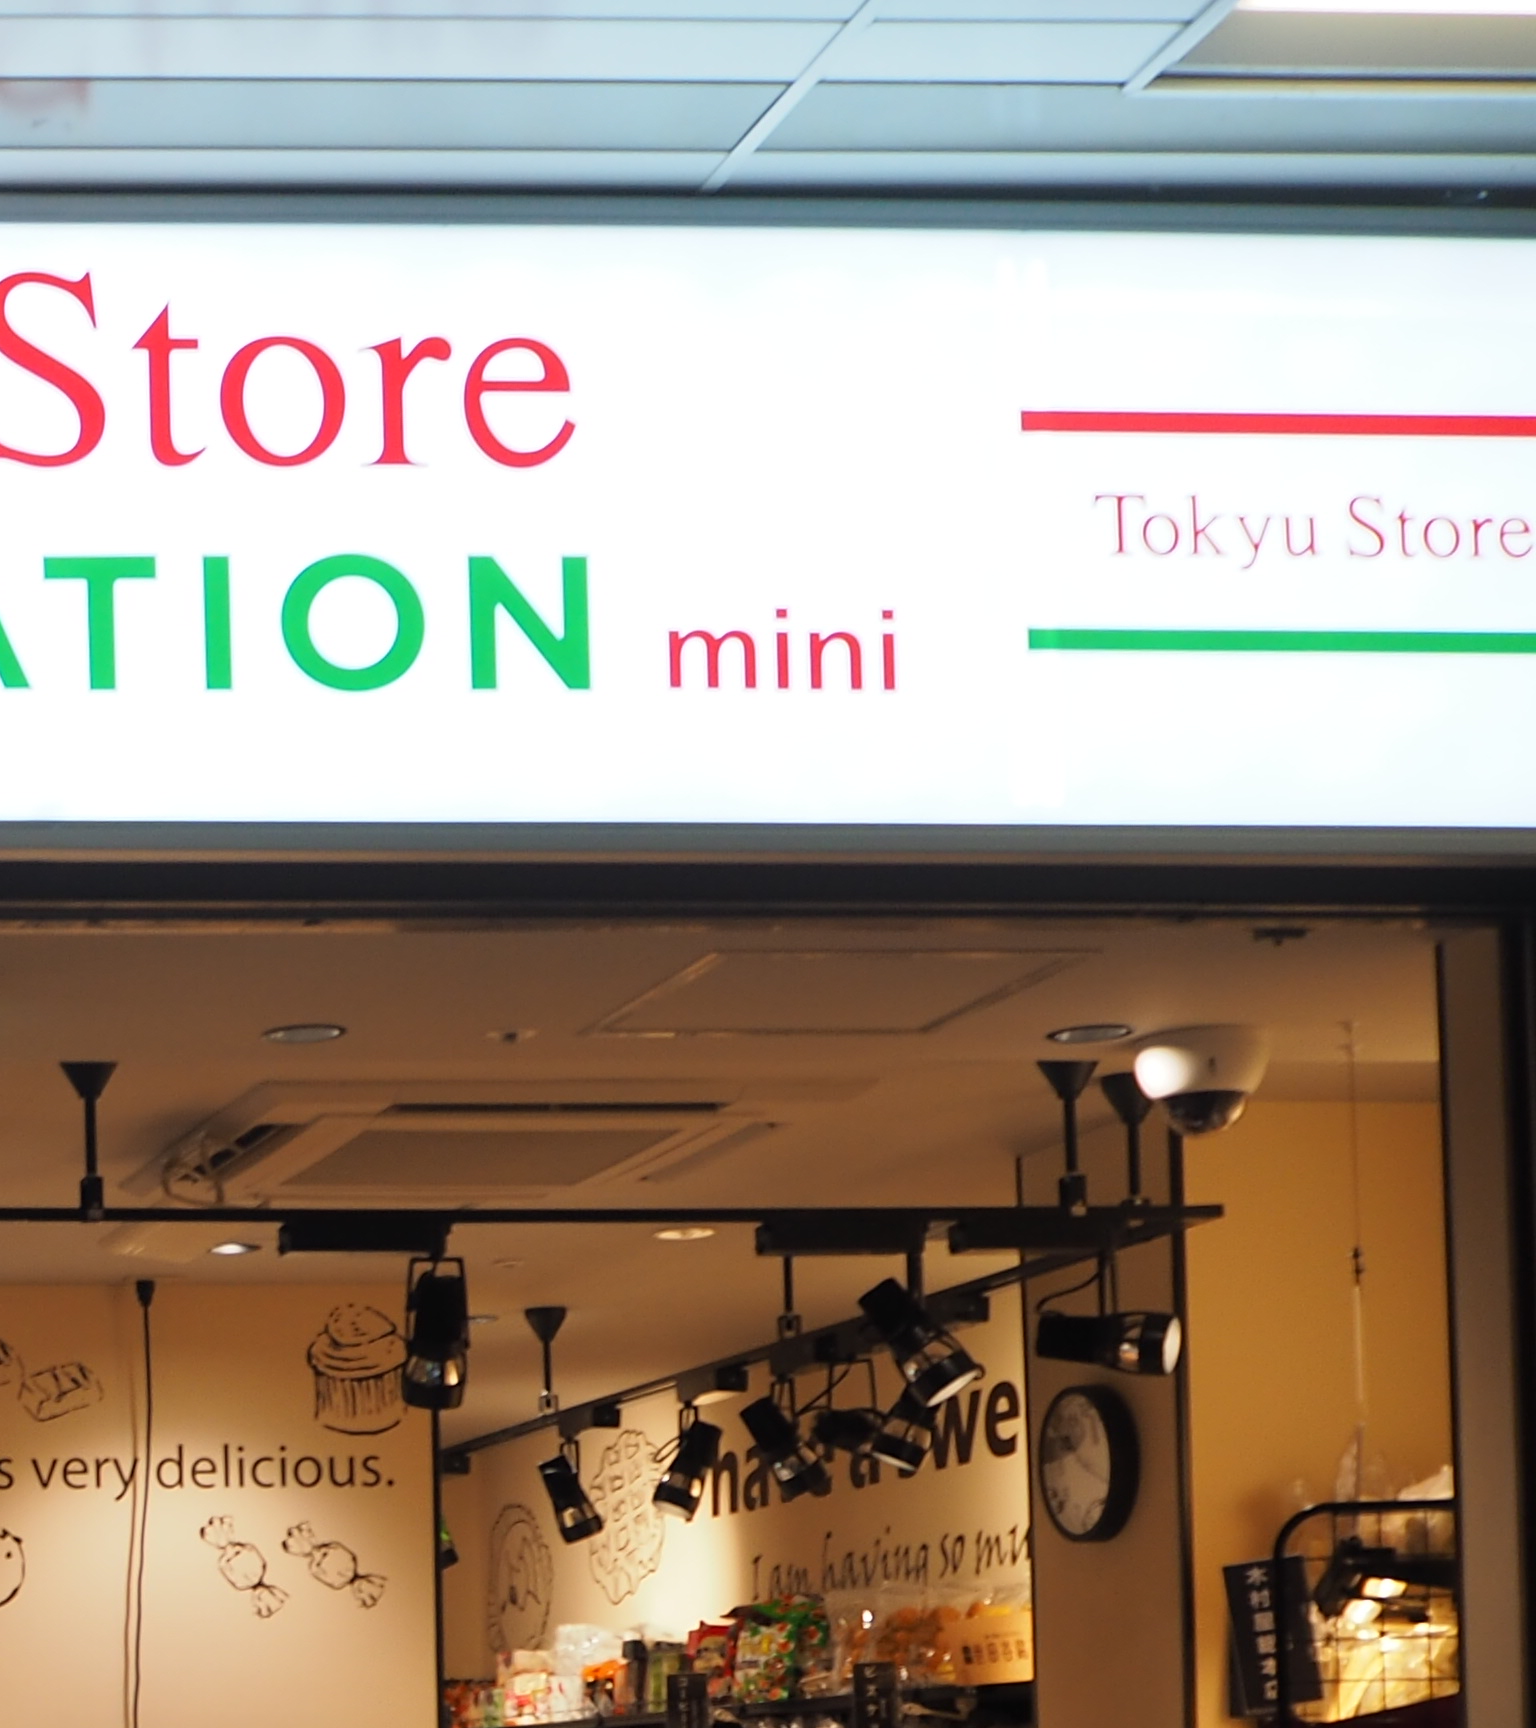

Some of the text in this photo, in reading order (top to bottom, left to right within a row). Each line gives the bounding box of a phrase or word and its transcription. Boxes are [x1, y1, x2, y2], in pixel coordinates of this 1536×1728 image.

[1094, 495, 1533, 570] Tokyu Store
[669, 608, 897, 692] mini
[30, 1457, 140, 1501] very
[155, 1444, 396, 1490] delicious.
[938, 1532, 965, 1579] so
